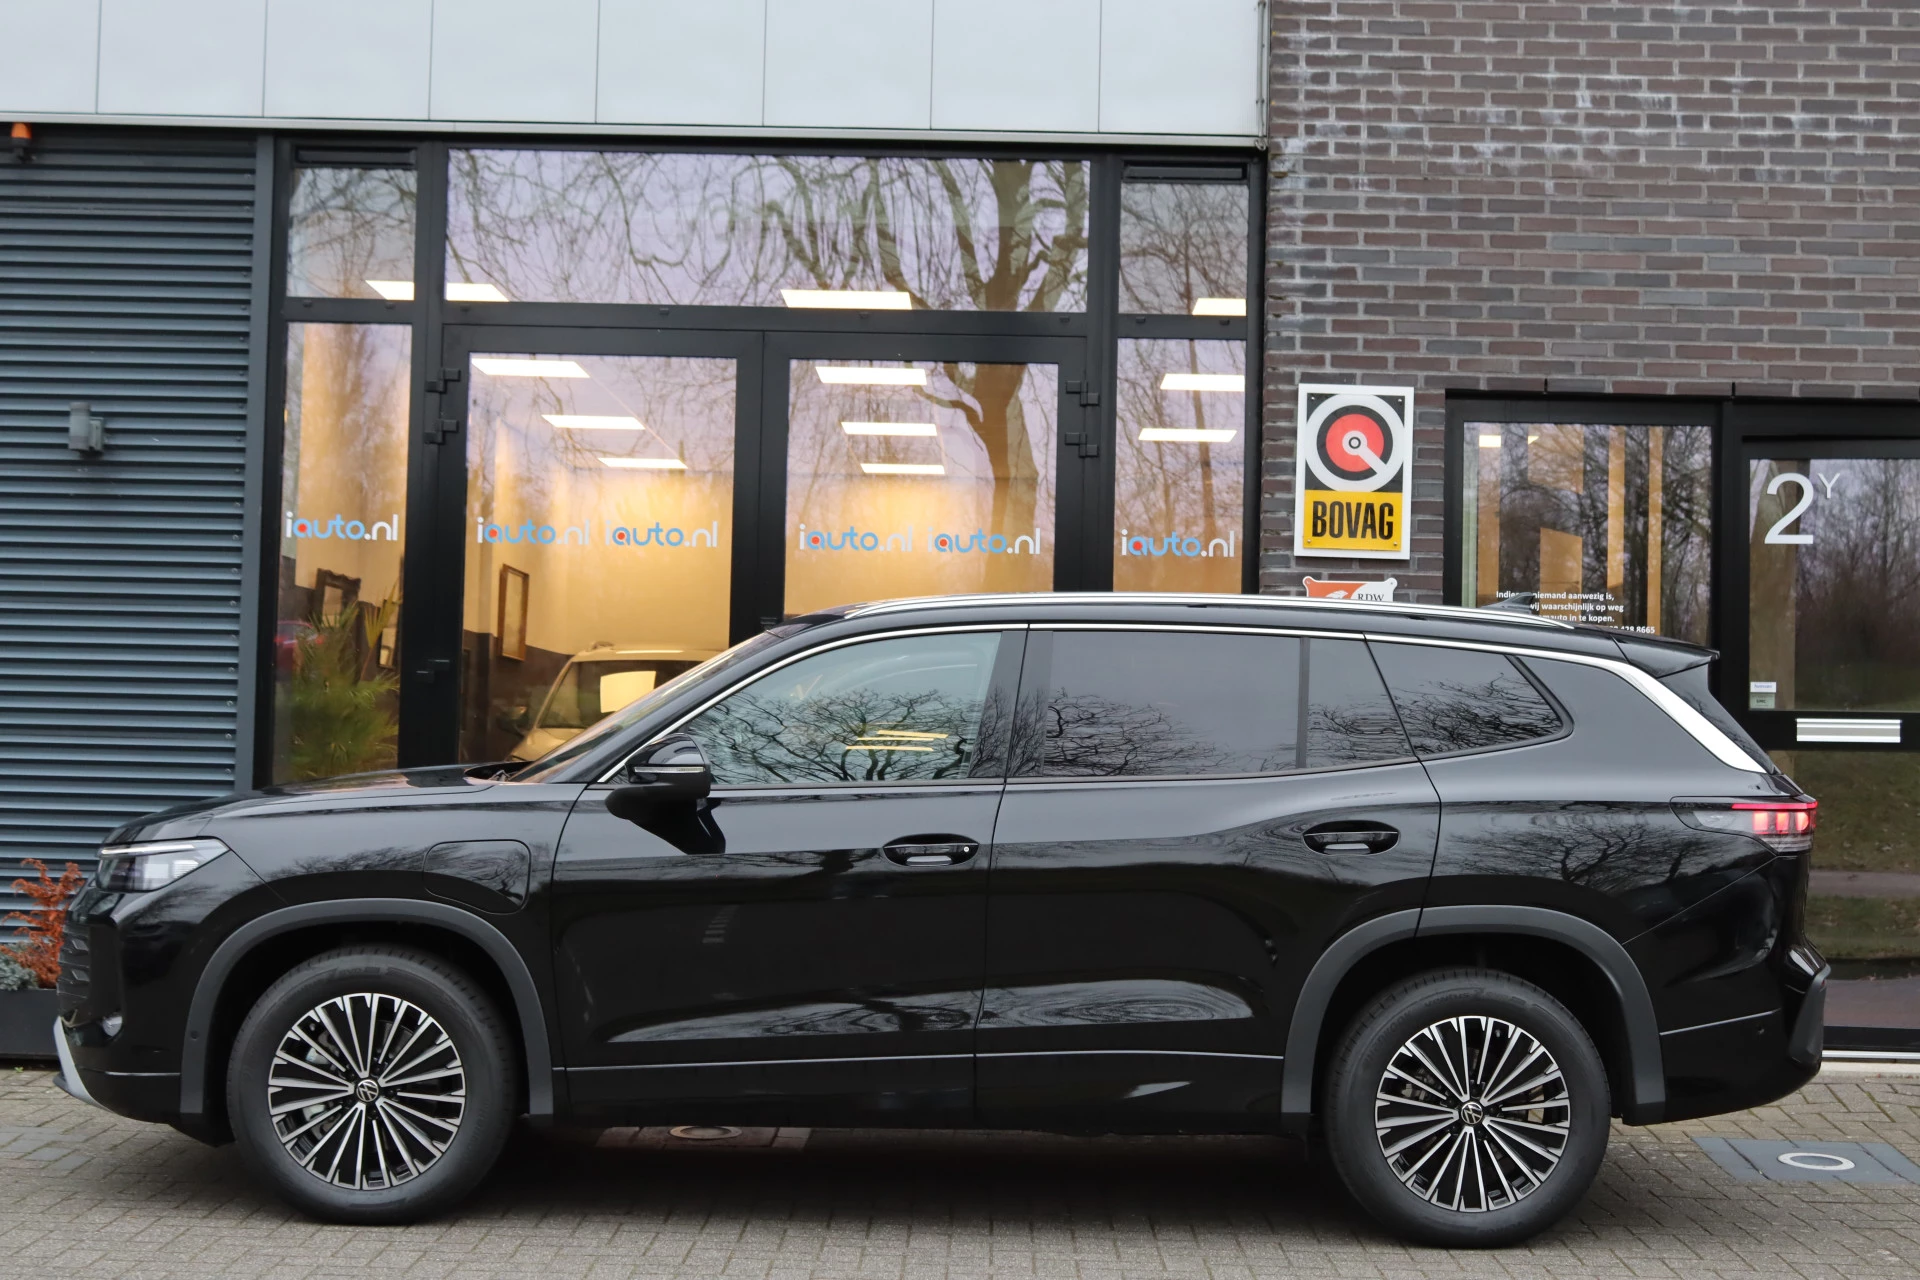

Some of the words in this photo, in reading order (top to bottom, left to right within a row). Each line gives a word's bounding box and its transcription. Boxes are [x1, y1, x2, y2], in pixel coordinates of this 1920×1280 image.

[285, 510, 399, 541] iauto.nl
[1312, 501, 1395, 541] BOVAG
[477, 516, 590, 546] iauto.nl
[1121, 528, 1234, 557] iauto.nl
[1357, 593, 1385, 602] RDW
[1532, 591, 1567, 599] niemand
[1568, 592, 1604, 601] aanwezig
[1605, 592, 1614, 601] is,
[1541, 602, 1594, 612] waarschijnlijk
[1579, 614, 1587, 622] te
[1588, 614, 1614, 623] kopen.
